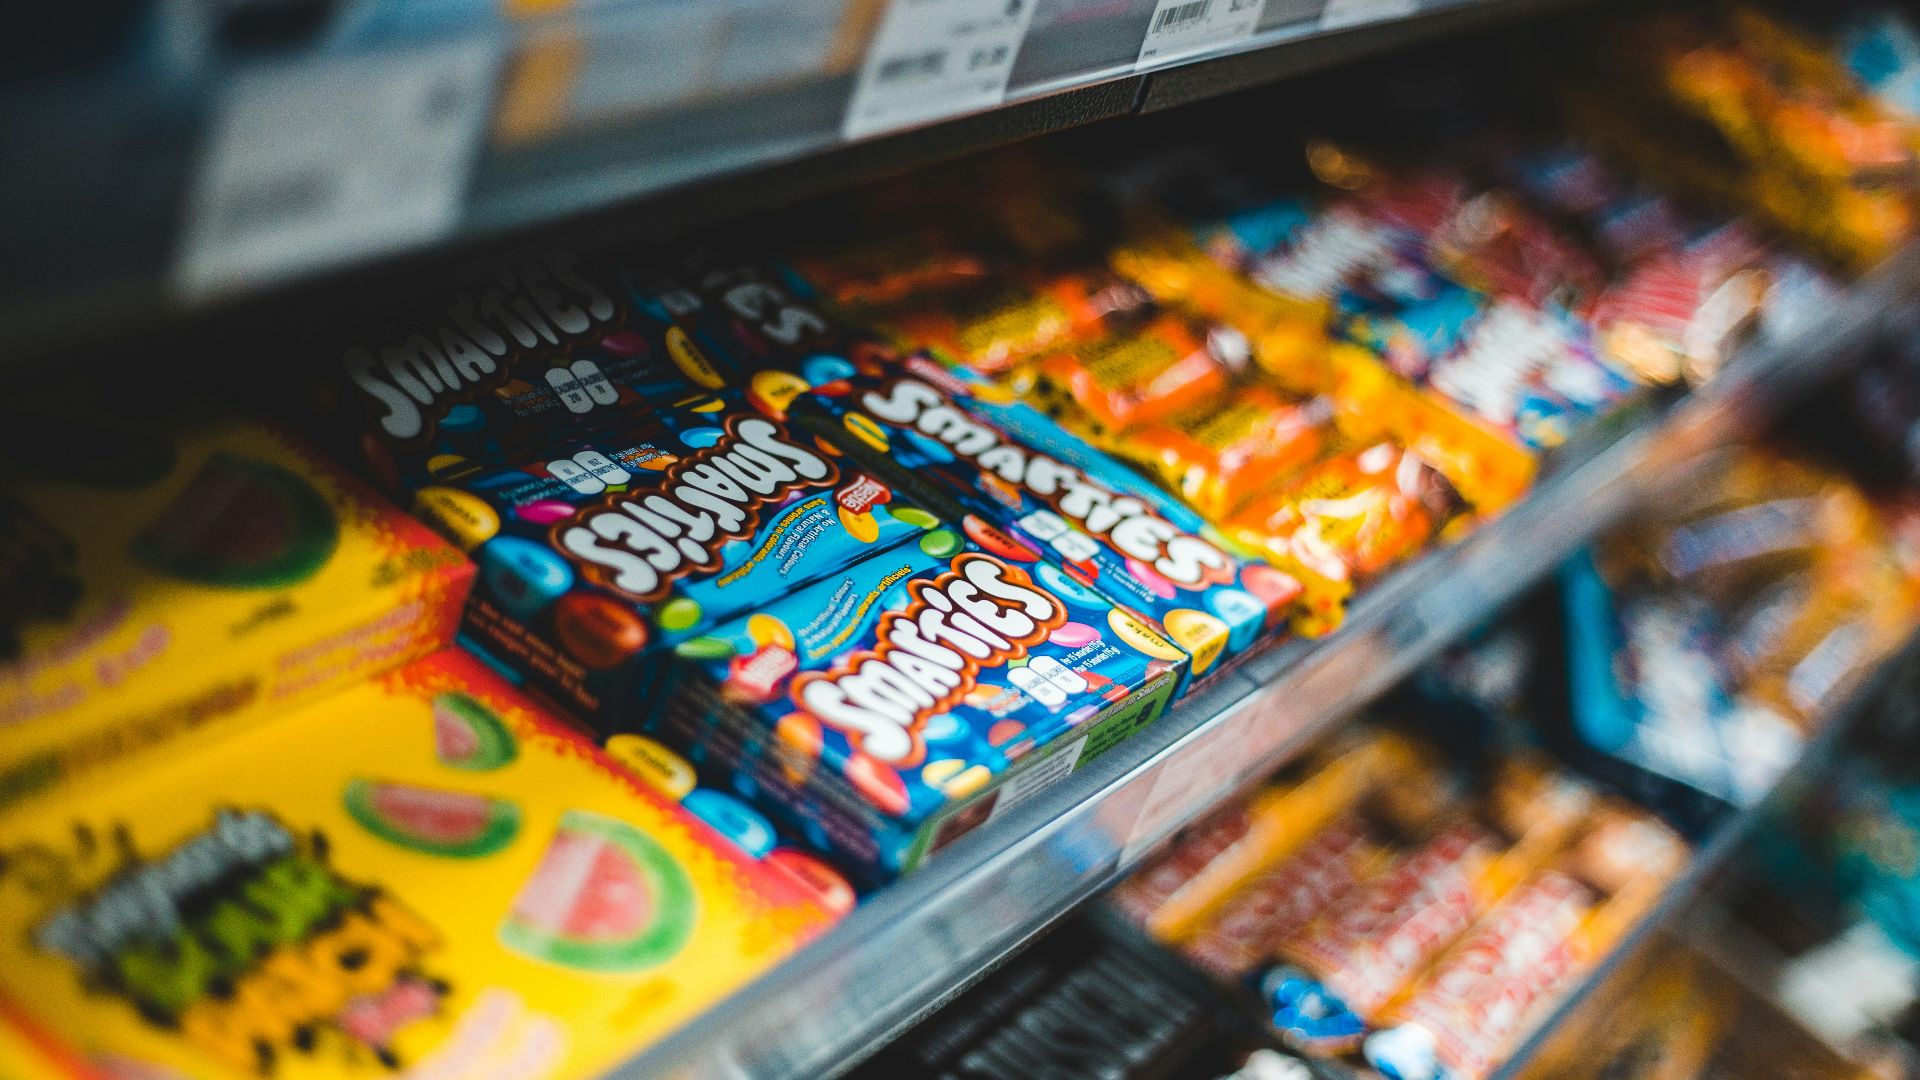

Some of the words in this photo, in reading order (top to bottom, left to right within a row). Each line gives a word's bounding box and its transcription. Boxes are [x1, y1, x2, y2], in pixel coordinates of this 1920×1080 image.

[803, 498, 827, 510] Sans
[794, 512, 821, 534] Natural
[821, 517, 836, 530] No
[775, 531, 799, 559] Flavours
[796, 525, 823, 551] Artificial
[1124, 620, 1165, 648] make
